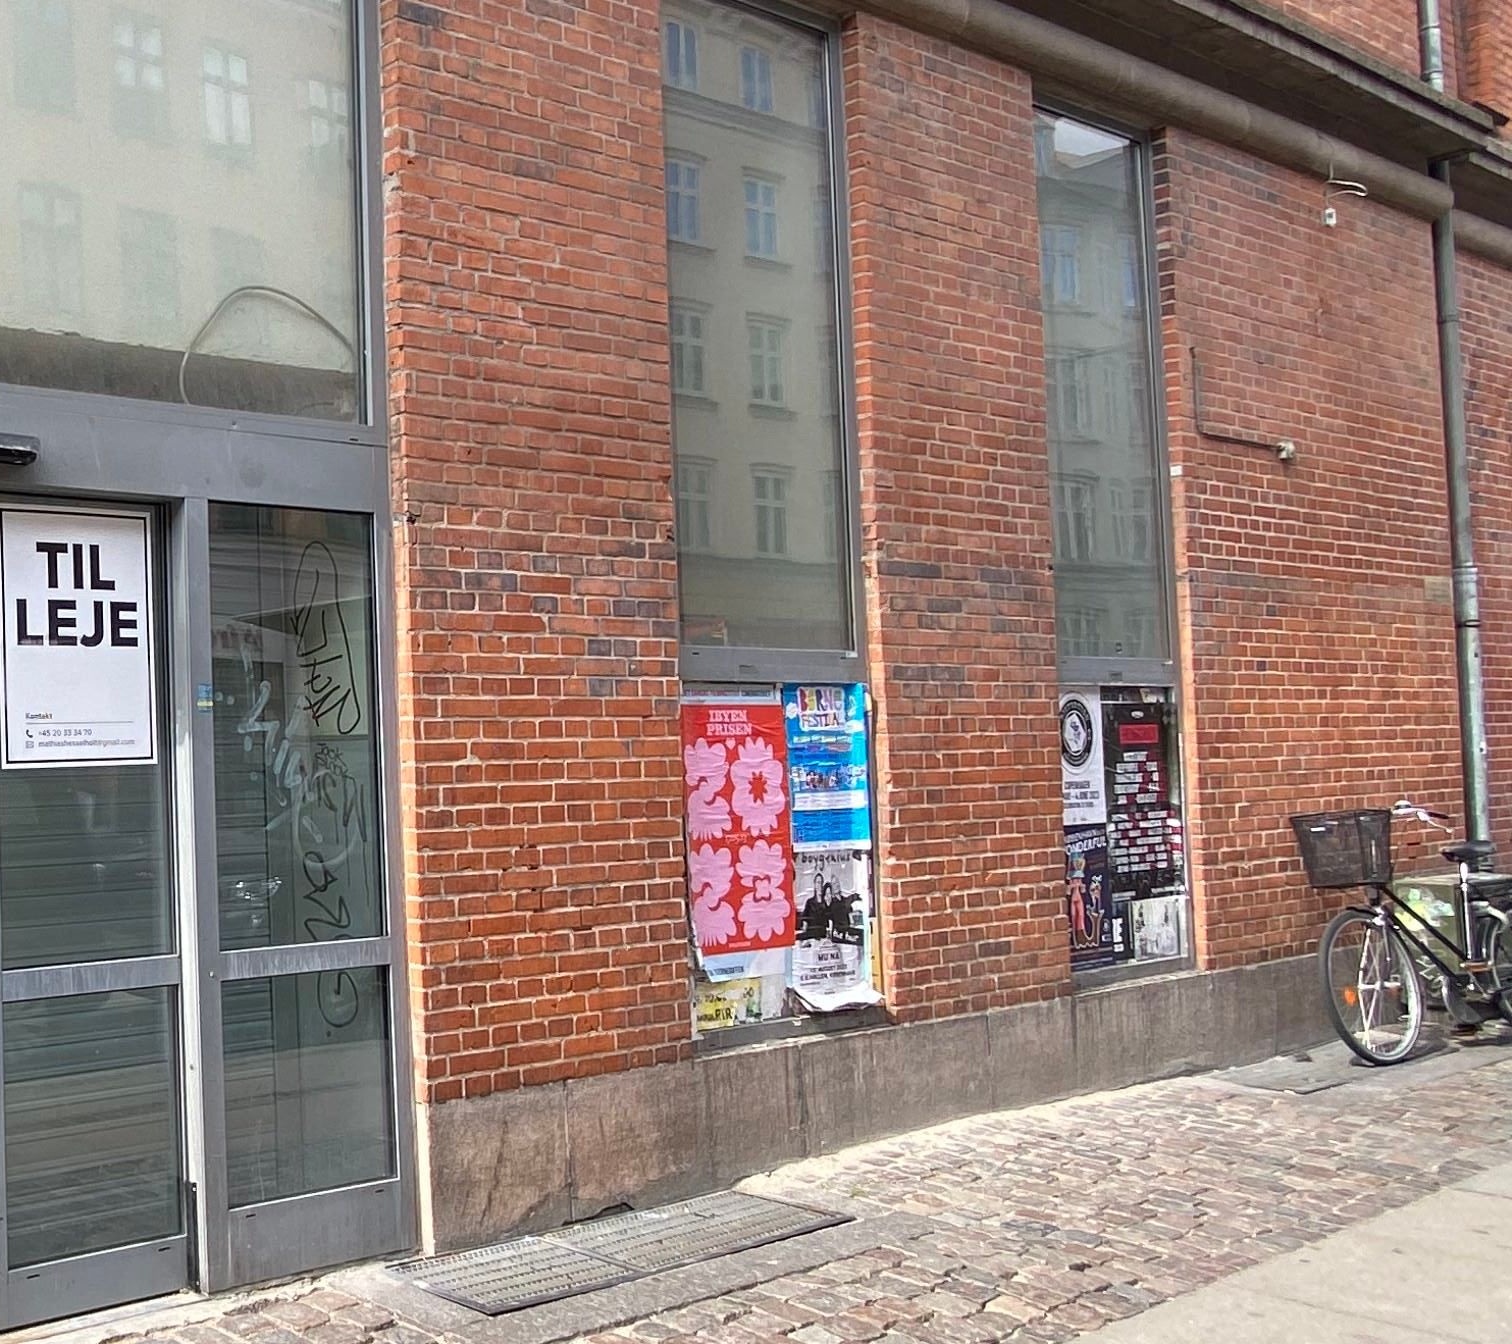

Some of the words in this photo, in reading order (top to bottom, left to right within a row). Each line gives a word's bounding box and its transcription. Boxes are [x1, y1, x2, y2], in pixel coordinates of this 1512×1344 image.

[36, 542, 115, 590] TIL
[16, 598, 138, 647] LEJE
[25, 712, 53, 720] Kontakt
[708, 709, 748, 722] IBYEN
[706, 723, 752, 737] PRISEN
[1065, 836, 1107, 856] ONDERFUL
[801, 852, 851, 871] boygenius
